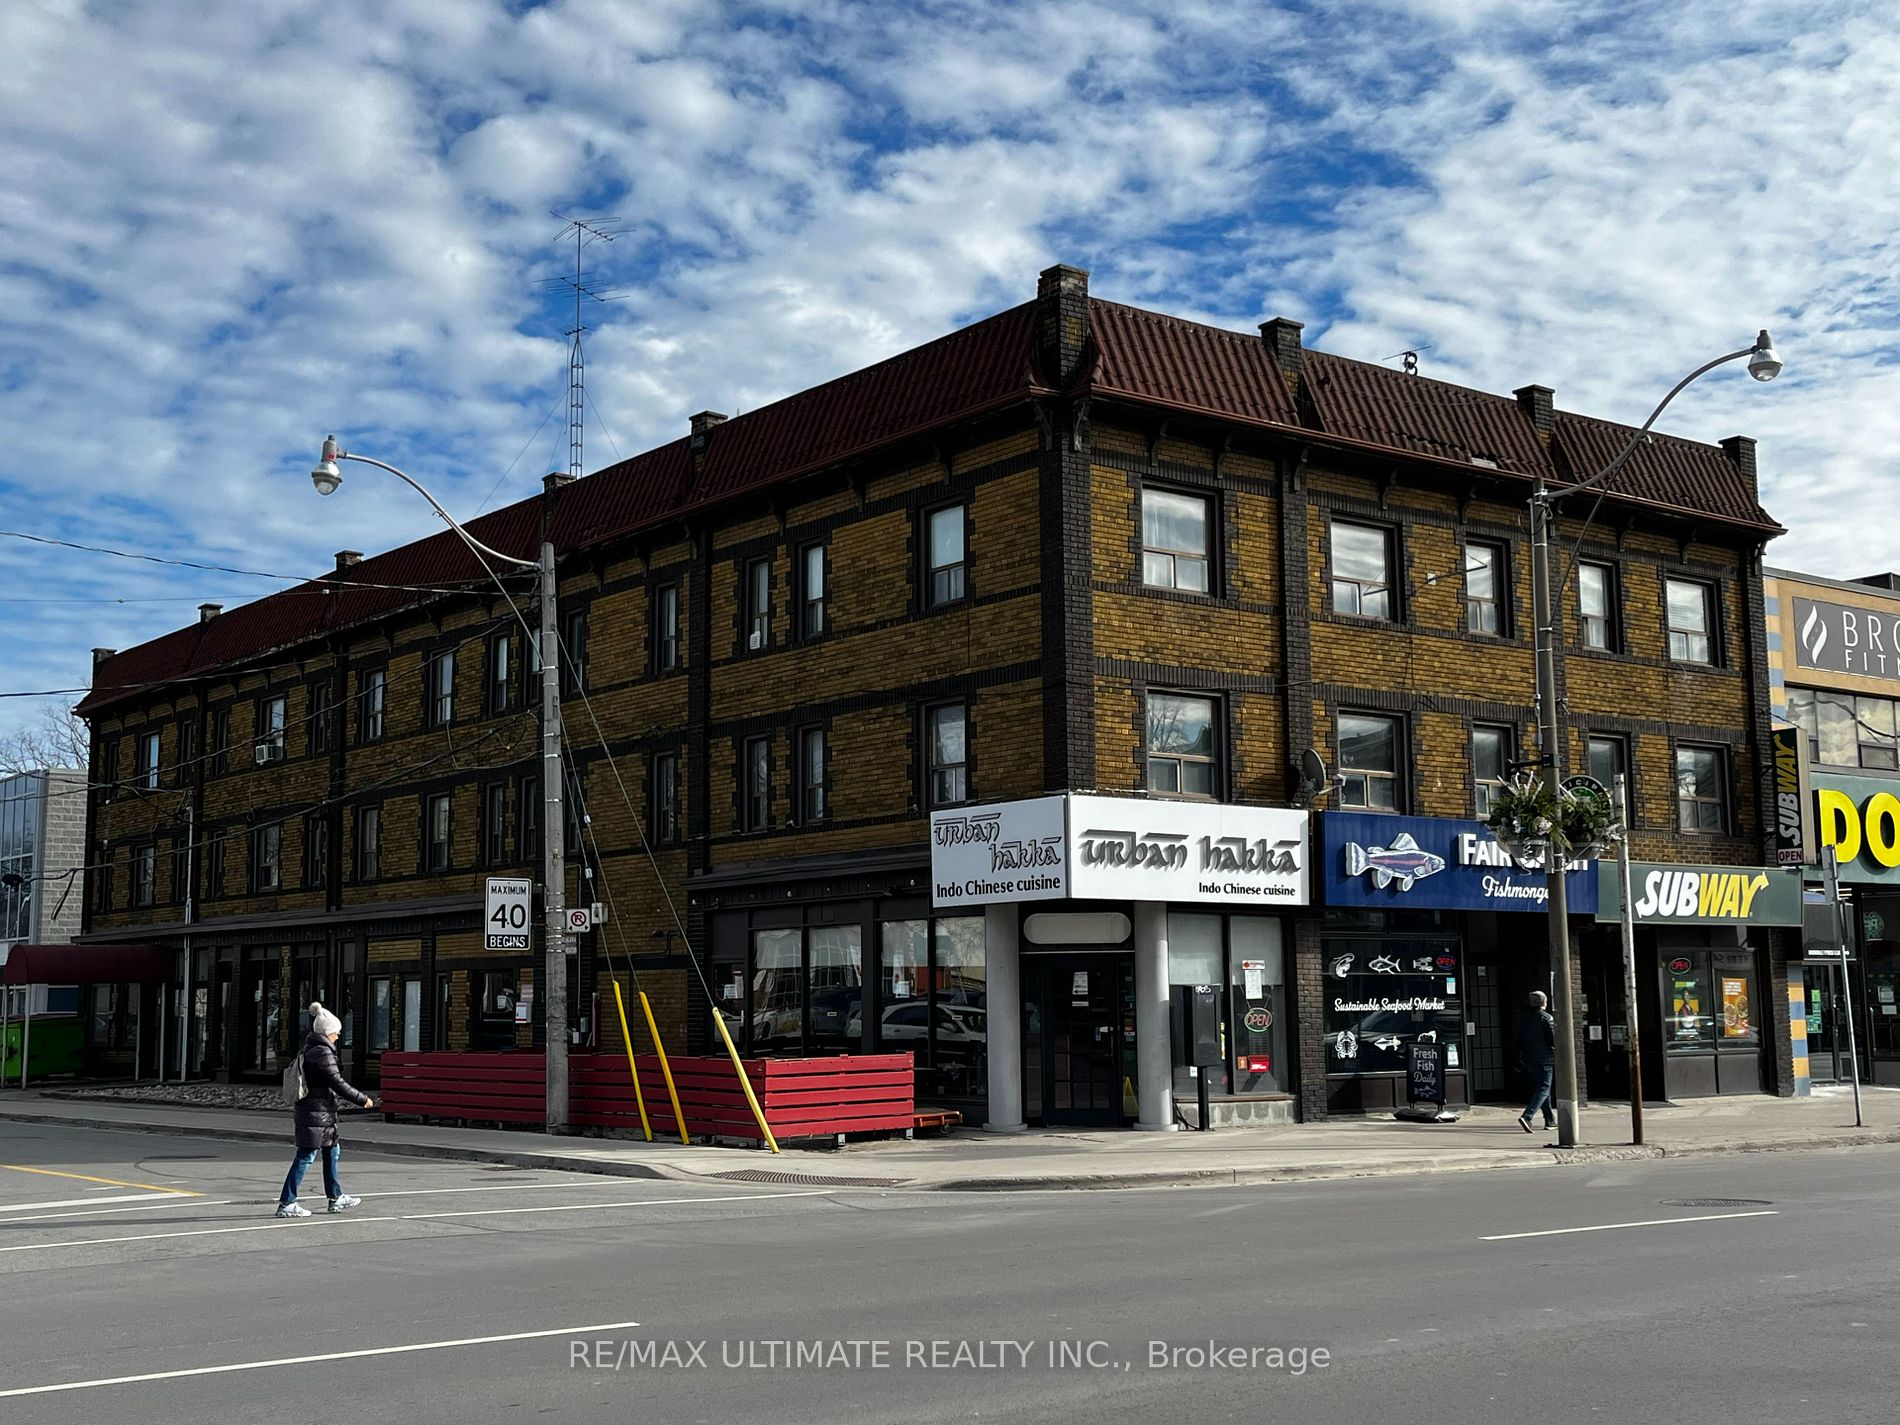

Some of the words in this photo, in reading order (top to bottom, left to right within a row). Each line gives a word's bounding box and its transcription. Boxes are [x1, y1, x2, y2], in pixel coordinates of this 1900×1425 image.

[1842, 610, 1900, 653] BR
[1845, 649, 1900, 676] FIT
[1773, 733, 1802, 847] SUBWAY
[1779, 850, 1802, 862] OPEN
[491, 885, 527, 895] MAXIMUM
[936, 882, 963, 898] Indo
[965, 879, 1014, 896] Chinese
[1016, 874, 1061, 892] cuisine
[1199, 882, 1221, 894] Indo
[1223, 882, 1261, 896] Chinese
[1263, 884, 1296, 897] cuisine
[1635, 870, 1770, 919] SUBWAY
[490, 904, 526, 929] 40
[490, 936, 526, 948] BEGINS
[1334, 998, 1380, 1012] Sustainable
[1381, 997, 1413, 1014] Seafood
[1413, 997, 1445, 1011] Market
[1247, 1014, 1269, 1026] OPEN
[1413, 1047, 1438, 1060] Fresh
[1416, 1060, 1435, 1072] Fish
[1413, 1071, 1436, 1086] Daily
